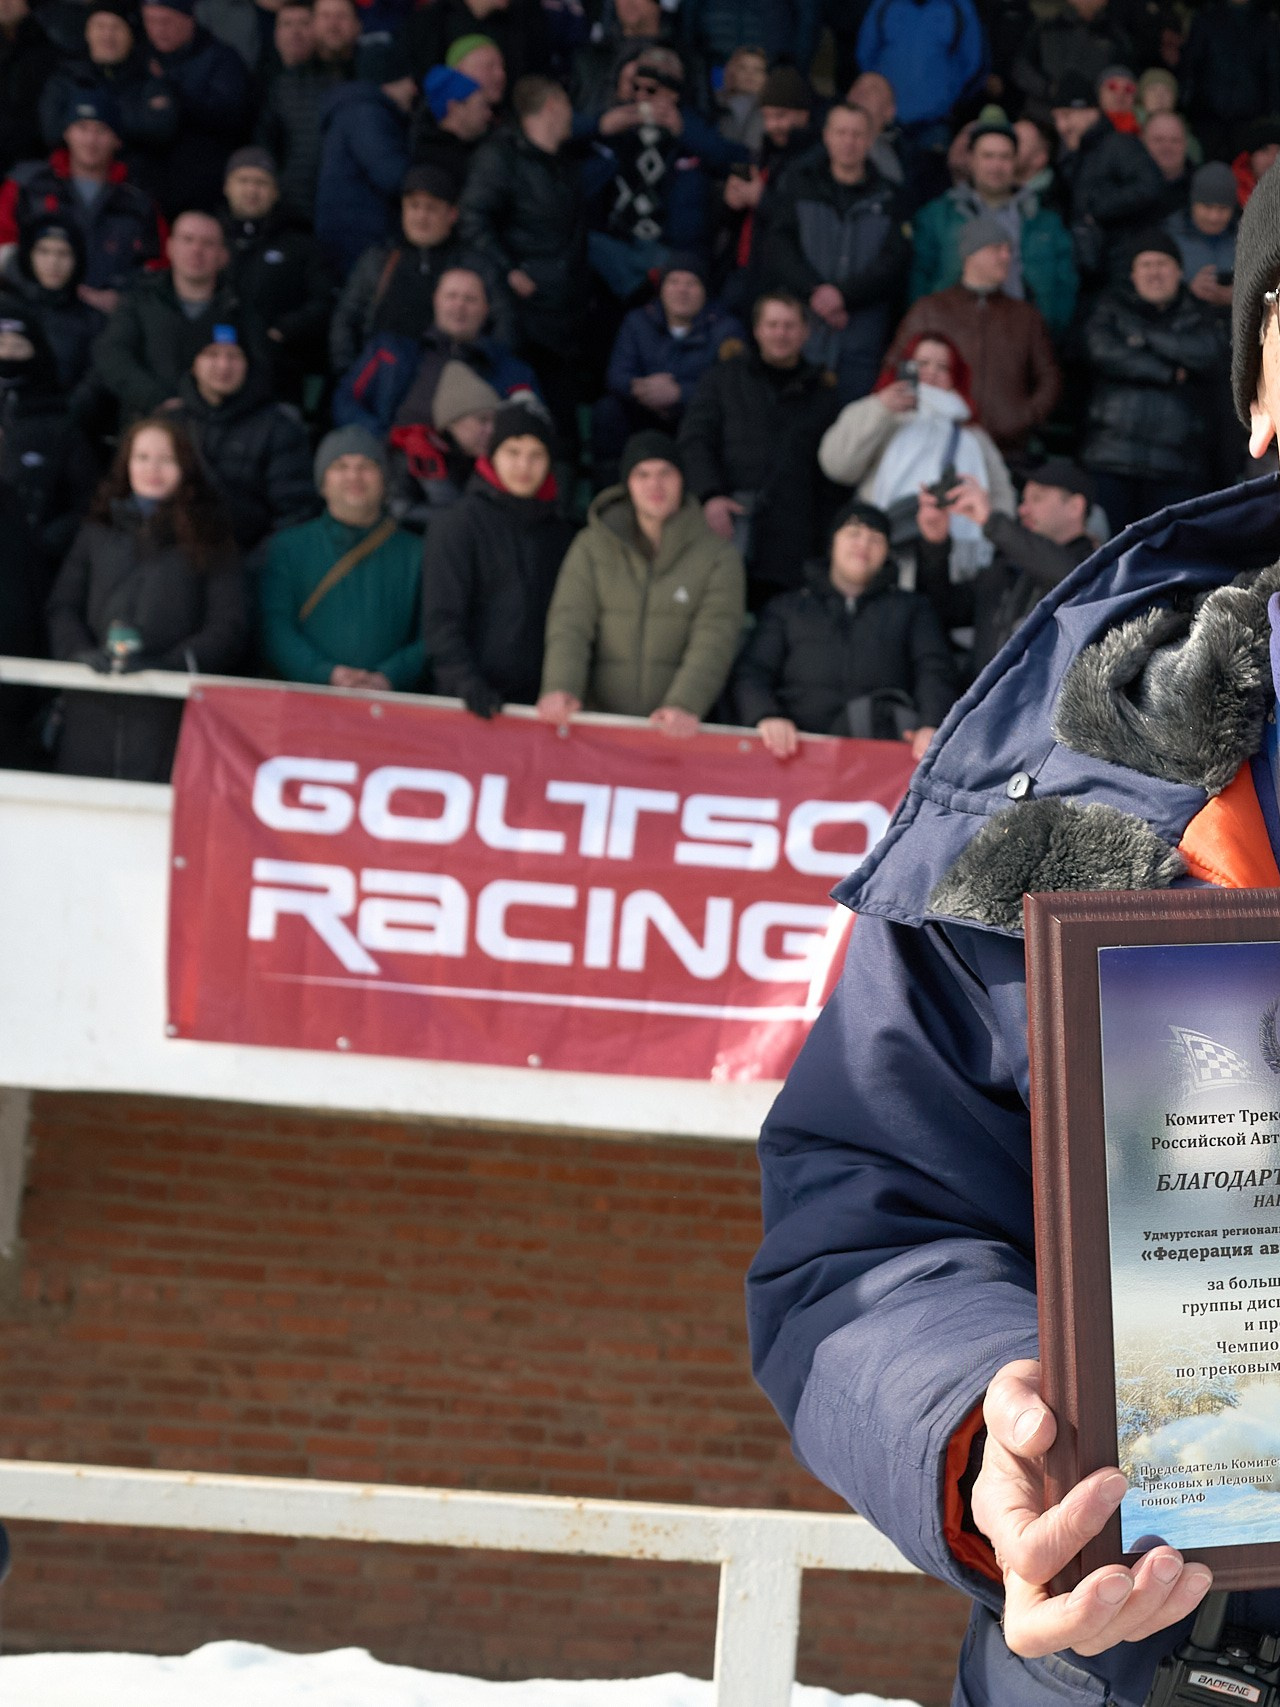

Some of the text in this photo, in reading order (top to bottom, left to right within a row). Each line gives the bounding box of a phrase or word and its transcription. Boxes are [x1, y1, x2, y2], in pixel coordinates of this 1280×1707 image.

[1165, 1112, 1234, 1127] Комитет
[1151, 1132, 1246, 1150] Российской
[1143, 1227, 1218, 1242] Удмуртская
[1141, 1243, 1253, 1263] «Федерация
[1207, 1279, 1224, 1291] за
[1182, 1299, 1243, 1316] группы
[1244, 1319, 1254, 1331] и
[1176, 1366, 1195, 1379] по
[1140, 1463, 1228, 1477] Председатель
[1140, 1478, 1202, 1492] Трековых
[1217, 1474, 1272, 1487] Ледовых
[1141, 1493, 1206, 1507] гонок РАФ
[1198, 1674, 1250, 1697] BAOFENG
